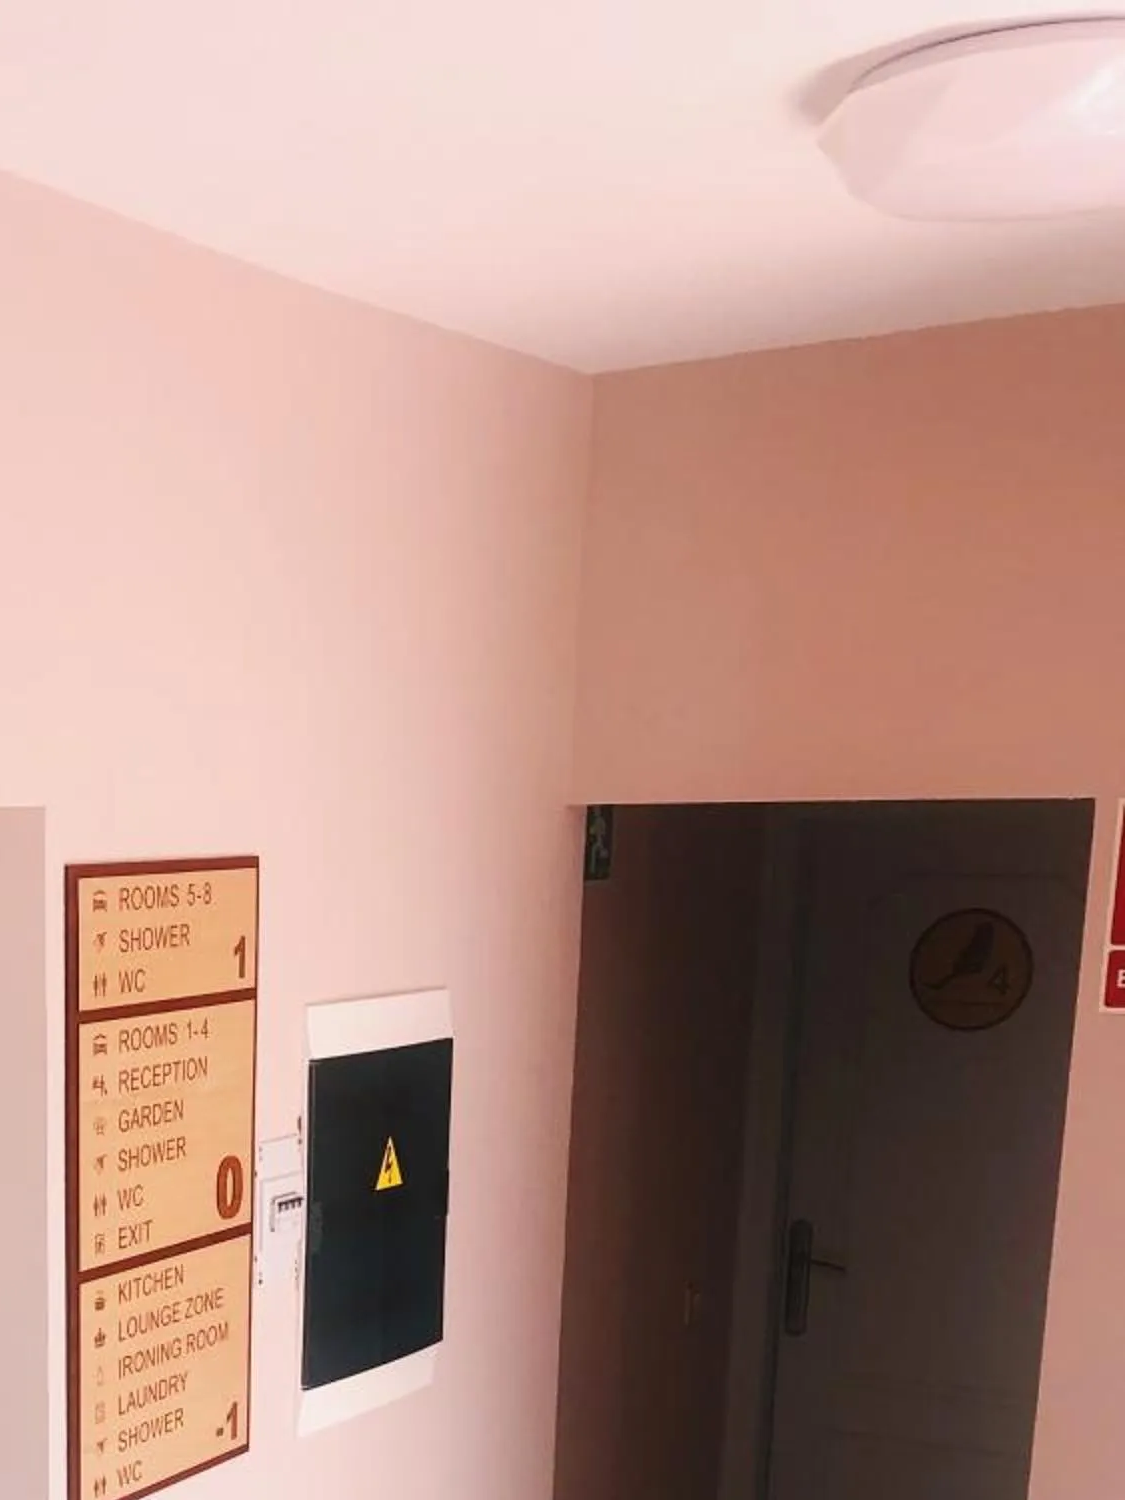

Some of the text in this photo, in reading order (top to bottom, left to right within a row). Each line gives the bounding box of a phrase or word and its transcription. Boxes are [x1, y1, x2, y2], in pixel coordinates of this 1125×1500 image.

[118, 881, 213, 911] ROOMS 5-8
[118, 923, 191, 953] SHOWER
[233, 935, 246, 979] 1
[118, 968, 147, 993] WC
[986, 962, 1013, 995] 4
[118, 1017, 210, 1053] ROOMS 1-4
[118, 1056, 208, 1094] RECEPTION
[118, 1099, 184, 1133] GARDEN
[117, 1136, 187, 1172] SHOWER
[117, 1184, 144, 1211] WC
[216, 1155, 244, 1220] 0
[118, 1219, 153, 1250] EXIT
[118, 1263, 185, 1304] KITCHEN
[118, 1287, 225, 1342] LOUNGE ZONE
[118, 1321, 229, 1380] IRONING ROOM
[118, 1371, 189, 1416] LAUNDRY
[118, 1407, 185, 1452] SHOWER
[216, 1401, 238, 1441] -1
[116, 1459, 143, 1487] WC
